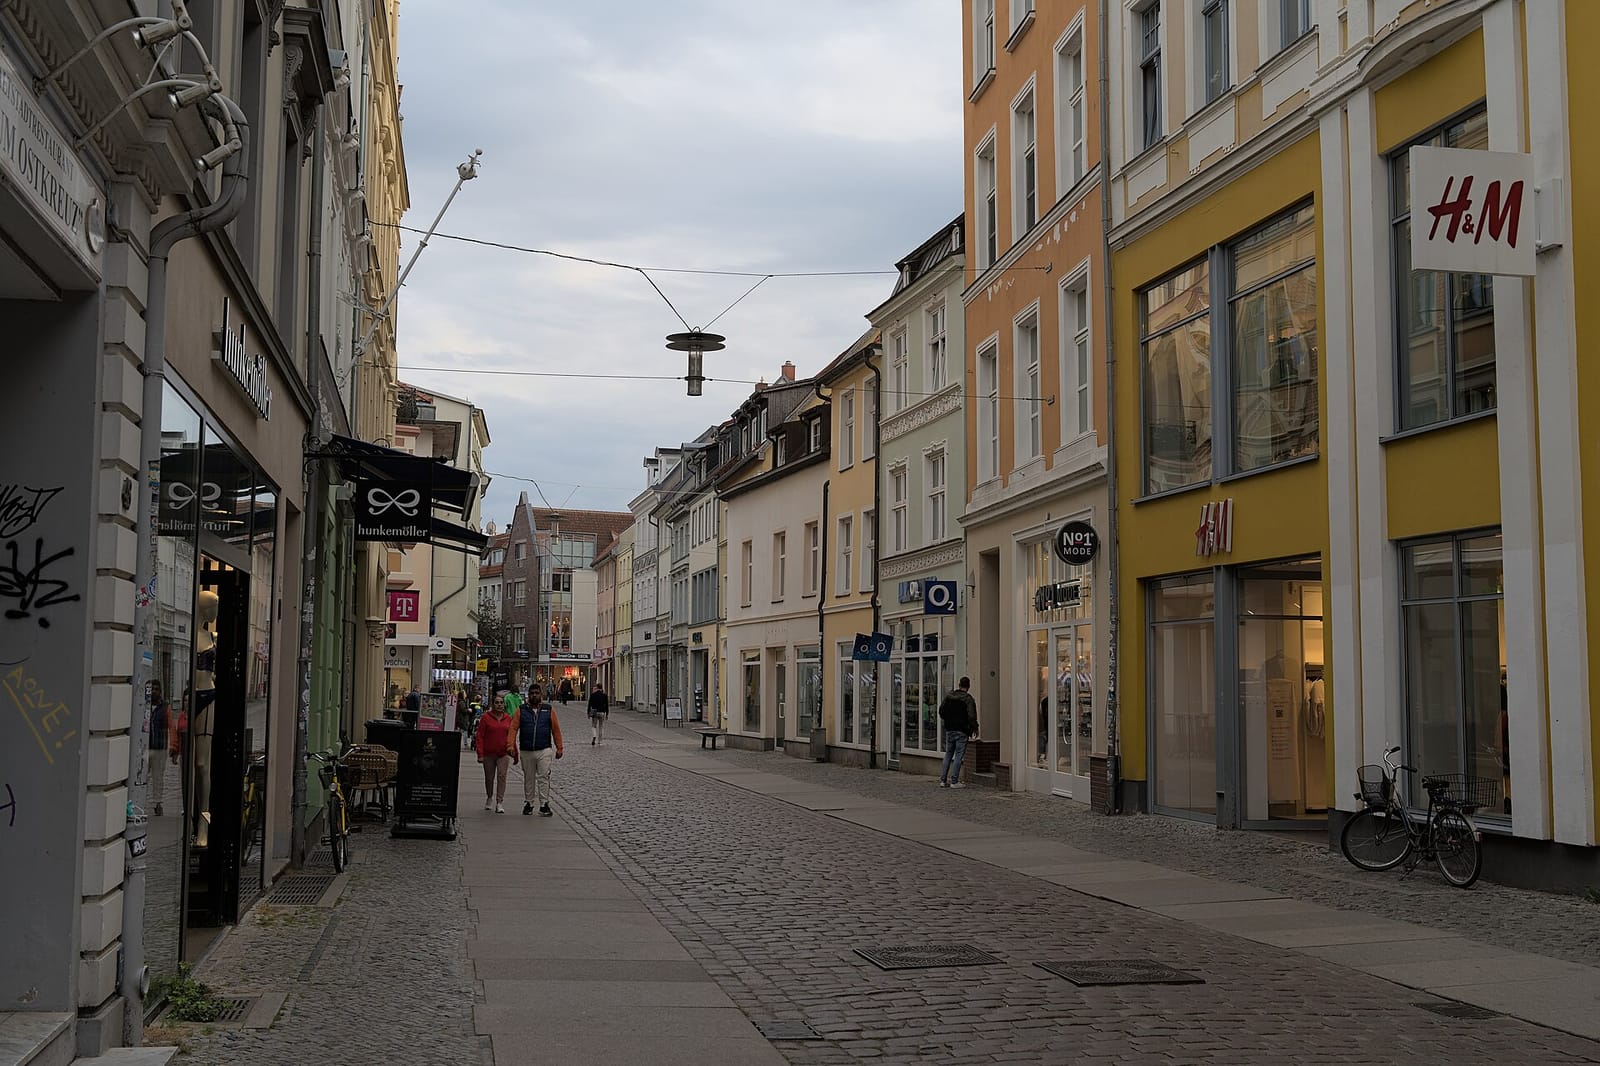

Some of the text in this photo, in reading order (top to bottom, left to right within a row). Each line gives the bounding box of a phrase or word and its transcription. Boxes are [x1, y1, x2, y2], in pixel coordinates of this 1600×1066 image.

[1427, 175, 1524, 249] H&M
[357, 523, 428, 537] hunkemöller
[1063, 547, 1092, 556] MODE
[396, 597, 413, 618] T
[928, 584, 955, 611] O2
